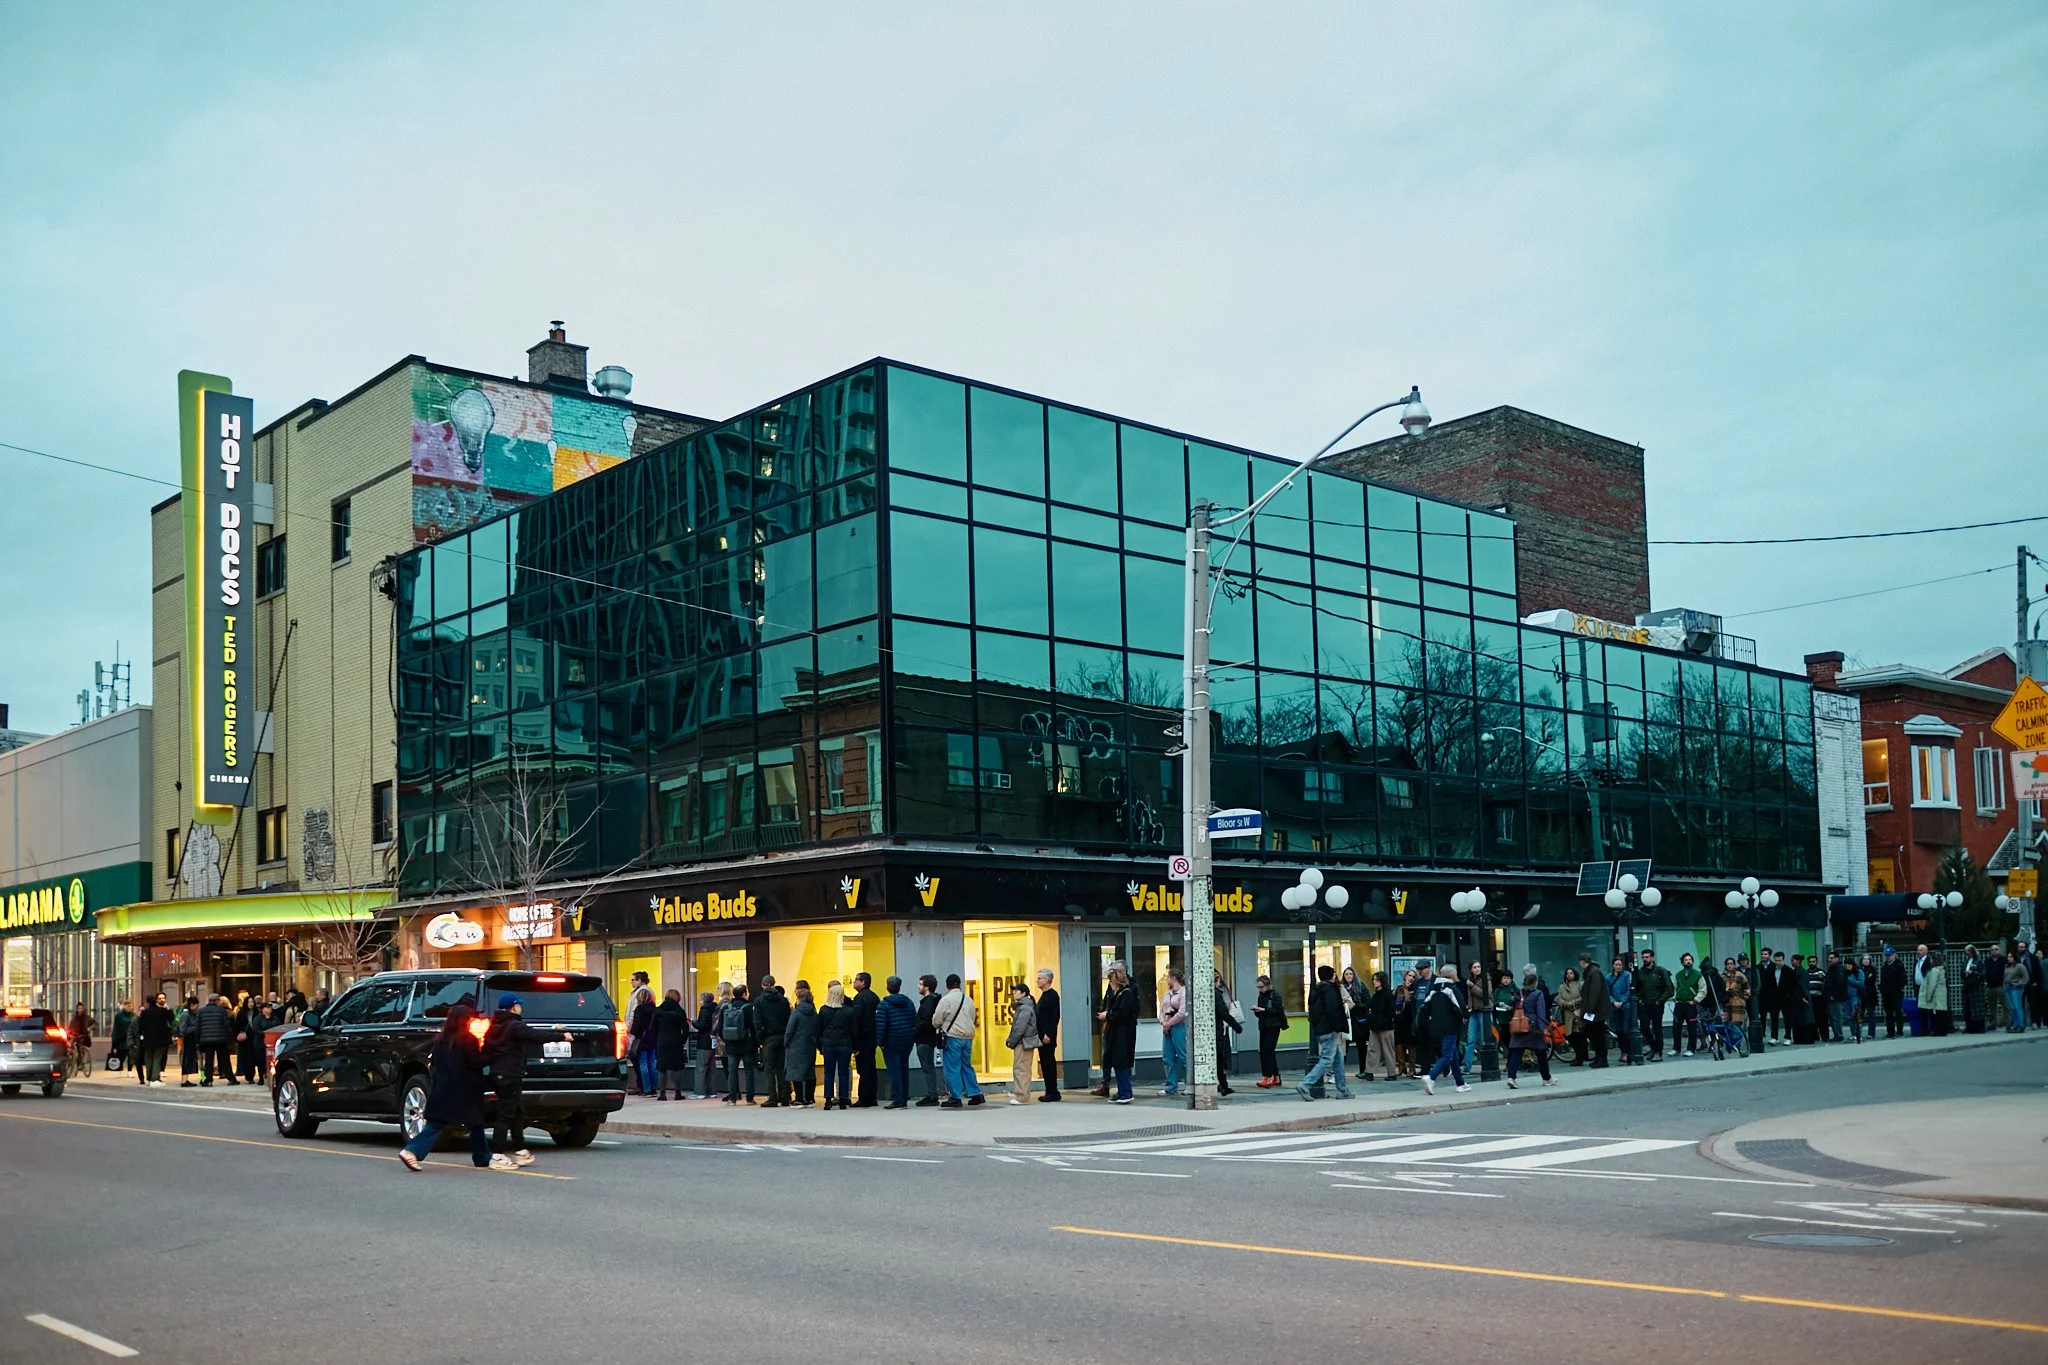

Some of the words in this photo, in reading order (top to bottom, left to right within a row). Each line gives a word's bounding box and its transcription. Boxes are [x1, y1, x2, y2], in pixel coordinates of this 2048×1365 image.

[220, 413, 241, 489] HOT
[220, 502, 241, 606] DOCS
[223, 615, 237, 663] TED
[223, 669, 237, 767] ROGERS
[2015, 696, 2047, 714] TRAFFIC
[2024, 732, 2047, 748] ZONE
[209, 774, 250, 784] CINEMA
[1217, 818, 1236, 829] Bloor
[1236, 819, 1243, 827] St
[1243, 816, 1251, 827] W
[653, 896, 704, 925] Value
[707, 889, 757, 921] Buds
[1131, 884, 1185, 912] Valu
[1211, 886, 1253, 913] uds
[994, 1004, 1016, 1026] LES
